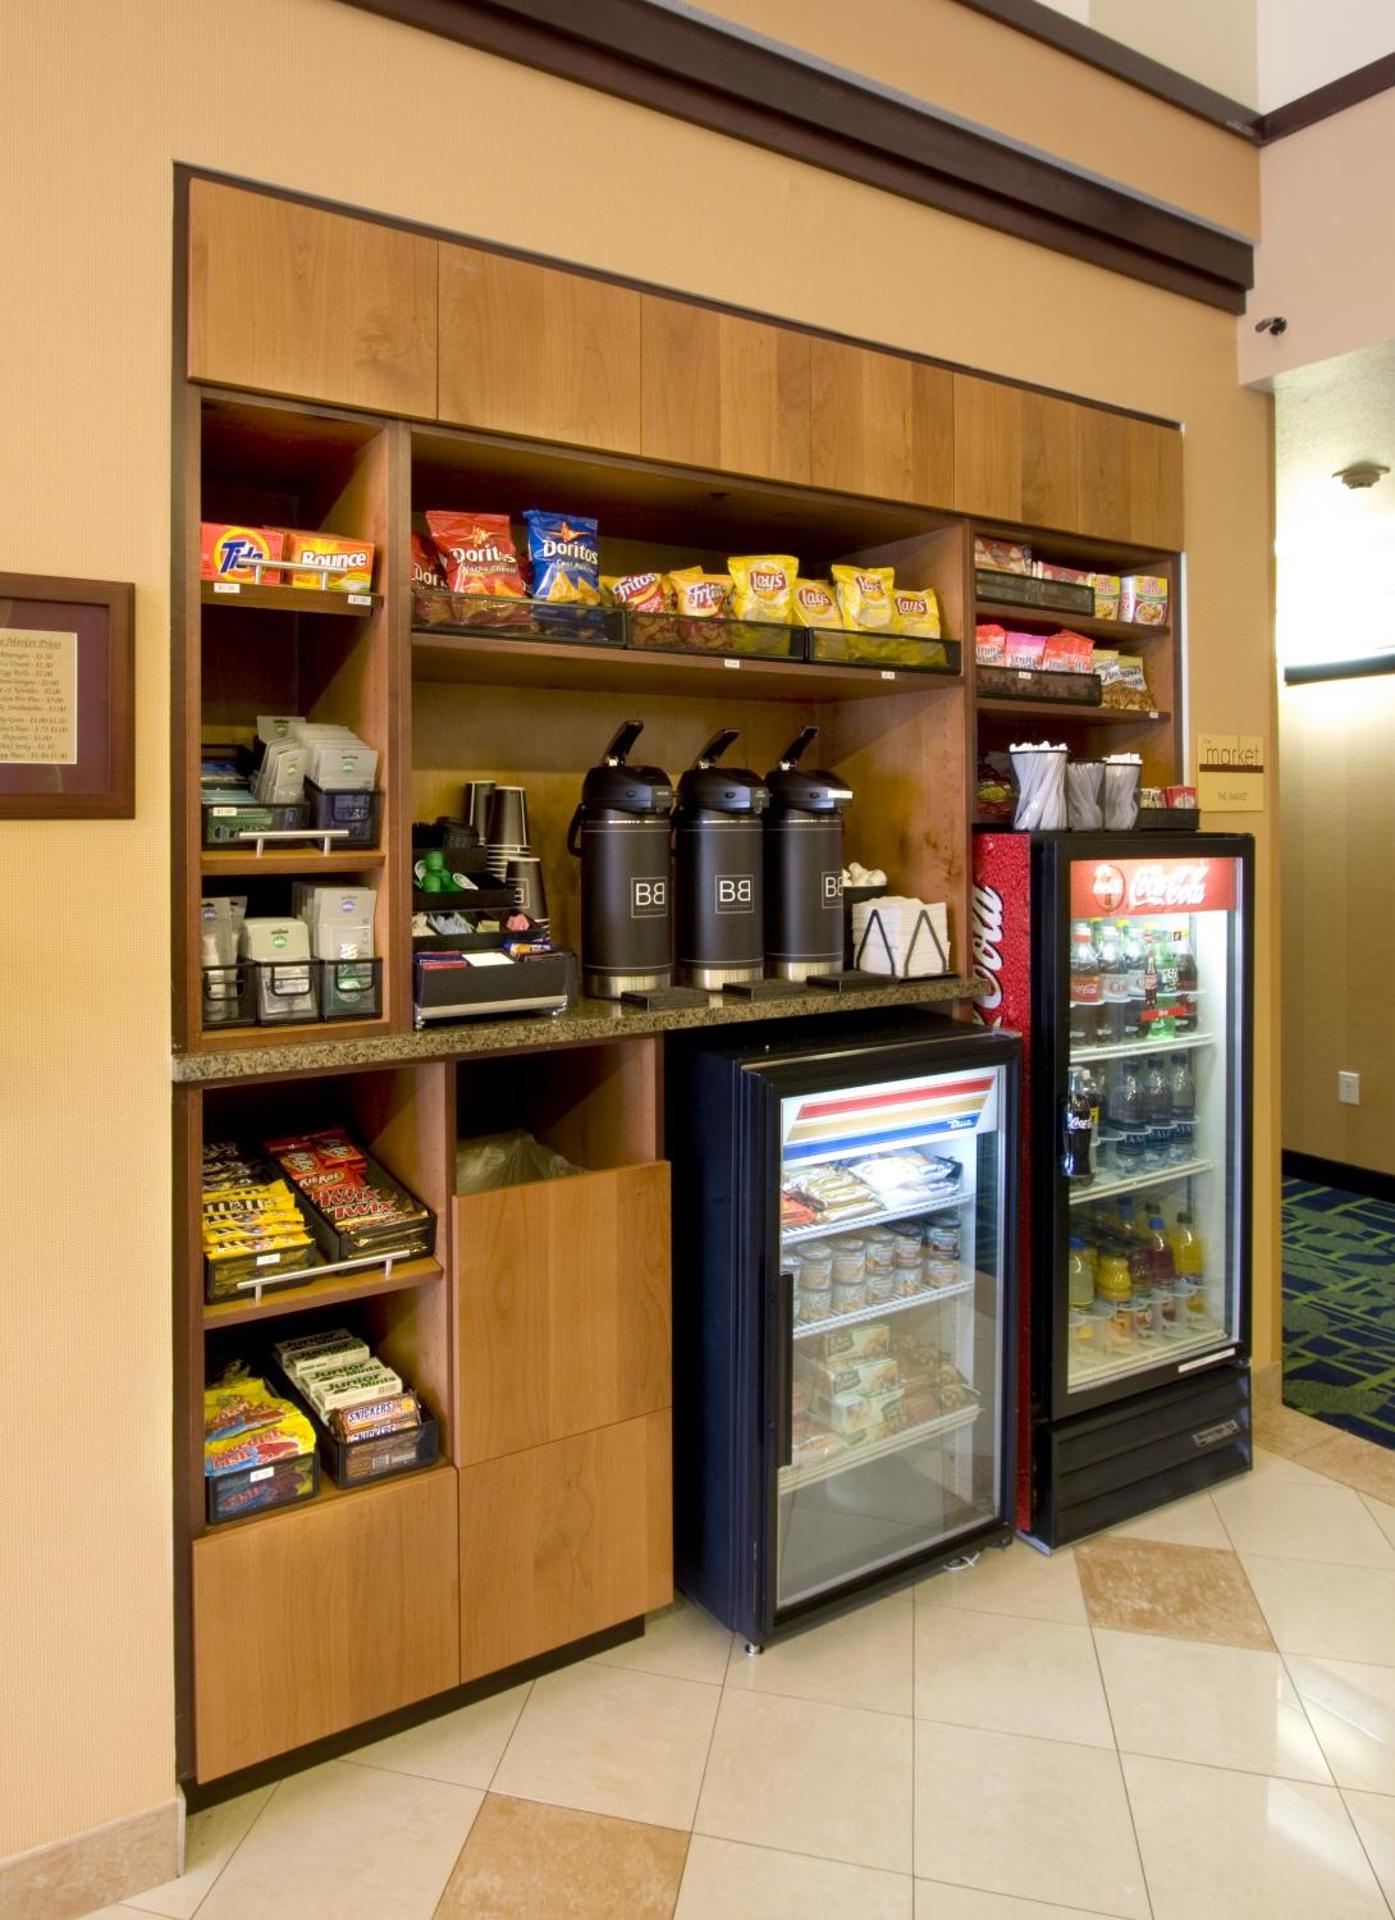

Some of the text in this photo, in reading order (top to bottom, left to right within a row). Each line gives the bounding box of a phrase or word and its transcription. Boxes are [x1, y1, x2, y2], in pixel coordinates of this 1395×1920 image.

[220, 541, 263, 573] Tide
[301, 551, 368, 568] Bounce
[449, 544, 516, 563] Doritos
[543, 538, 599, 565] Doritos
[613, 572, 657, 603] Fritos
[1206, 737, 1260, 765] market
[313, 1362, 367, 1379] Junior
[325, 1373, 384, 1392] Junior
[360, 1376, 397, 1389] Mints
[347, 1402, 393, 1423] SNICKERS
